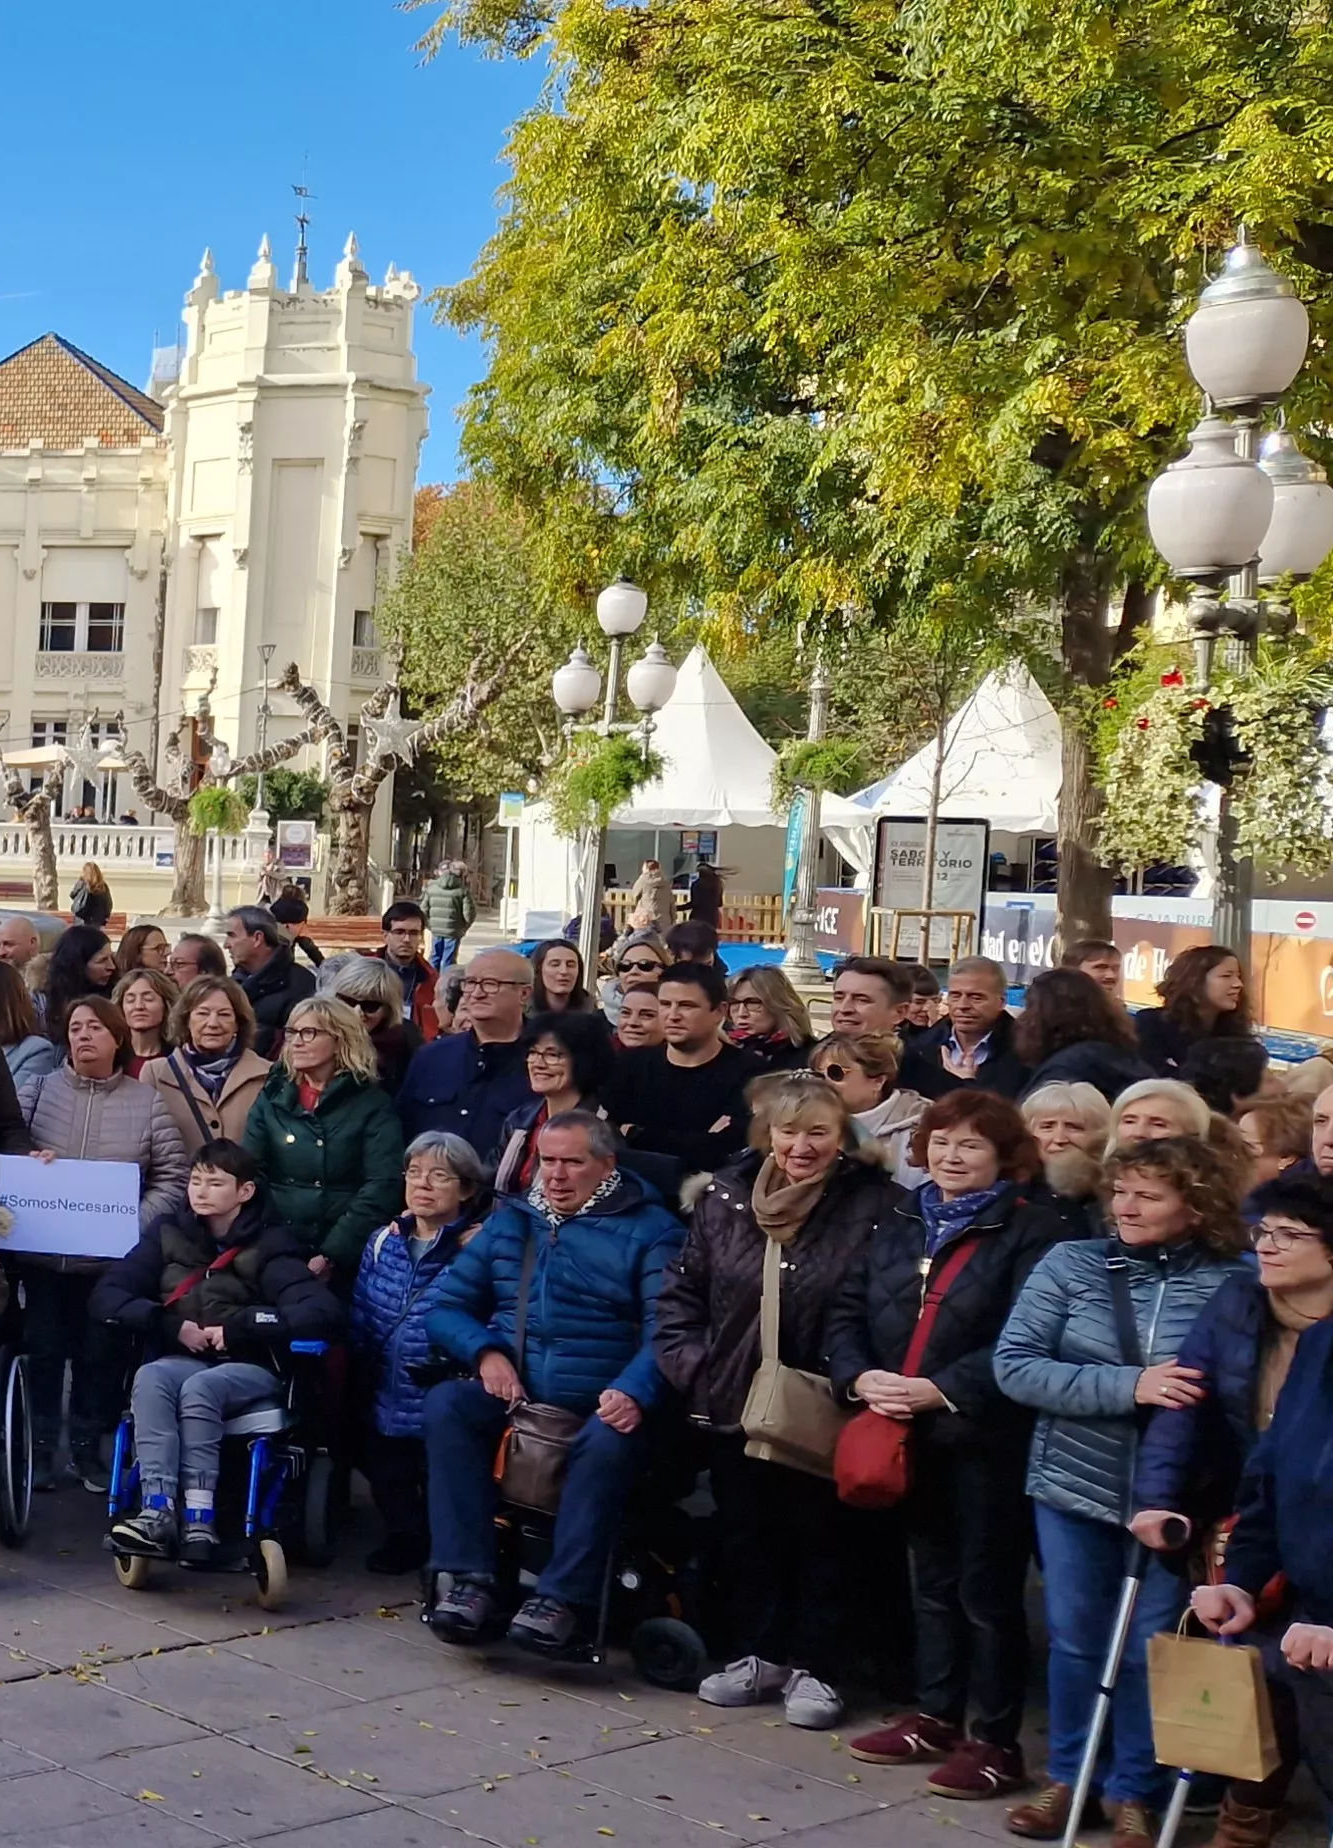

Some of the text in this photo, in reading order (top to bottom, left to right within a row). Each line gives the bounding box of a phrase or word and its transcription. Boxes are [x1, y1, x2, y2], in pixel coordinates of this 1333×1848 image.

[891, 857, 973, 869] TERRORIO
[942, 851, 951, 860] Y
[1008, 938, 1026, 964] en
[1124, 944, 1148, 981] de
[0, 1193, 137, 1217] #SomosNecesarios
